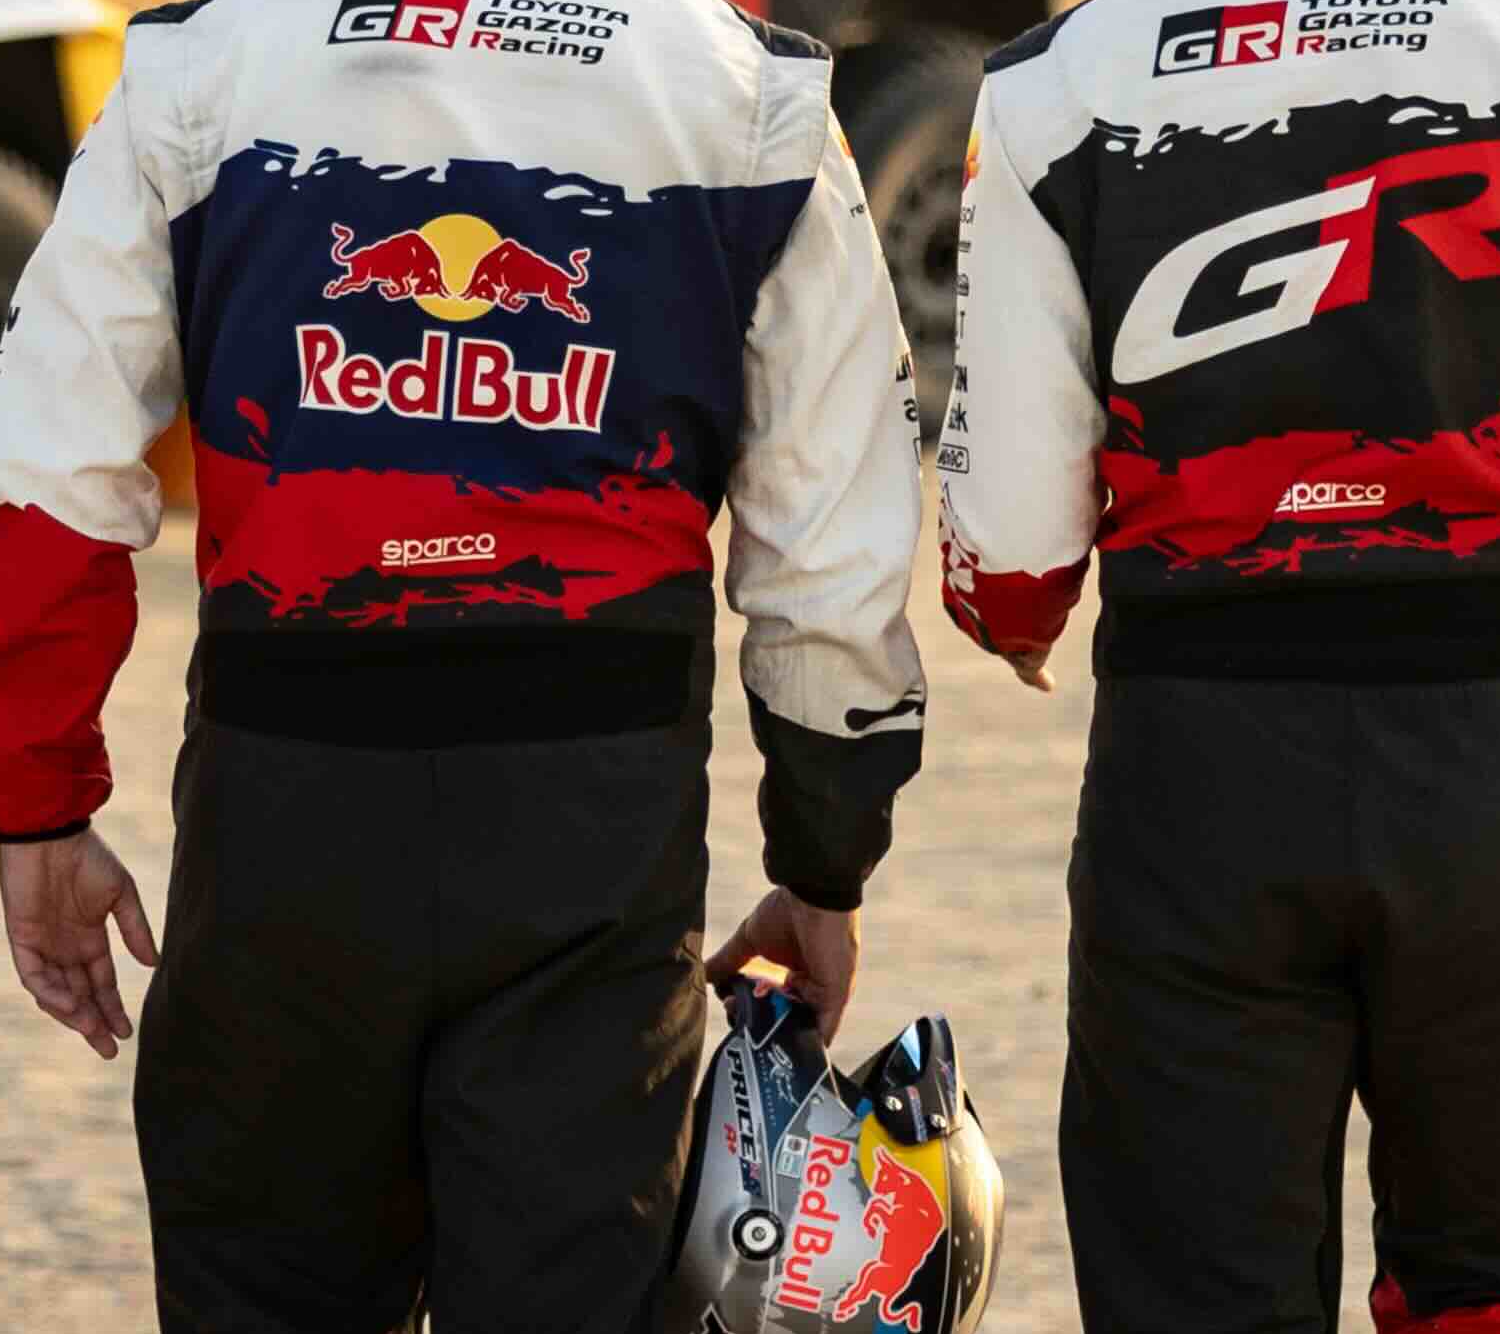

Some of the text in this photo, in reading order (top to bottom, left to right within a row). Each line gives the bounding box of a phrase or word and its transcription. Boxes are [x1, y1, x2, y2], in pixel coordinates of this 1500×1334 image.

[335, 5, 459, 46] GR
[477, 10, 613, 40] GAZOO
[1299, 10, 1433, 32] GAZOO
[469, 31, 605, 65] Racing
[1158, 21, 1280, 72] GR
[1296, 29, 1427, 55] Racing
[296, 324, 616, 435] Red Bull
[382, 533, 496, 567] sparco
[726, 1047, 761, 1165] PRICE
[776, 1132, 854, 1313] Red Bull
